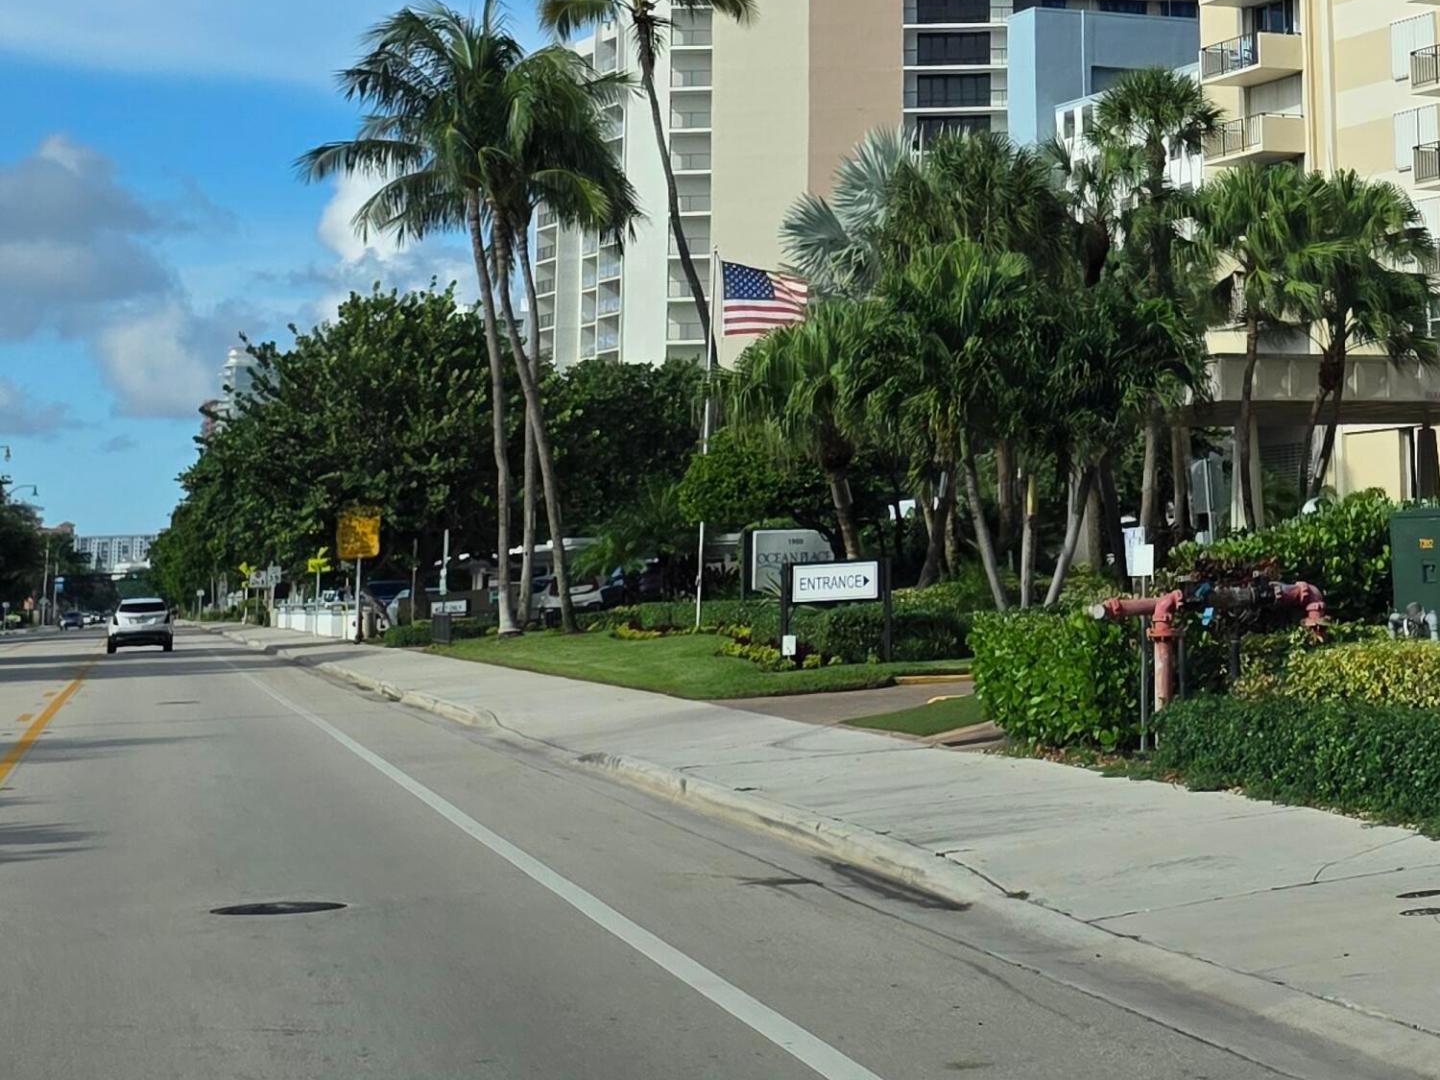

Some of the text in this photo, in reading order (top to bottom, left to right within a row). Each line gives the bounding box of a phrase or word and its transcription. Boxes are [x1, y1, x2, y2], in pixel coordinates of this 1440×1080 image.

[757, 551, 832, 564] OCEAN PLACE
[799, 574, 862, 592] ENTRANCE
